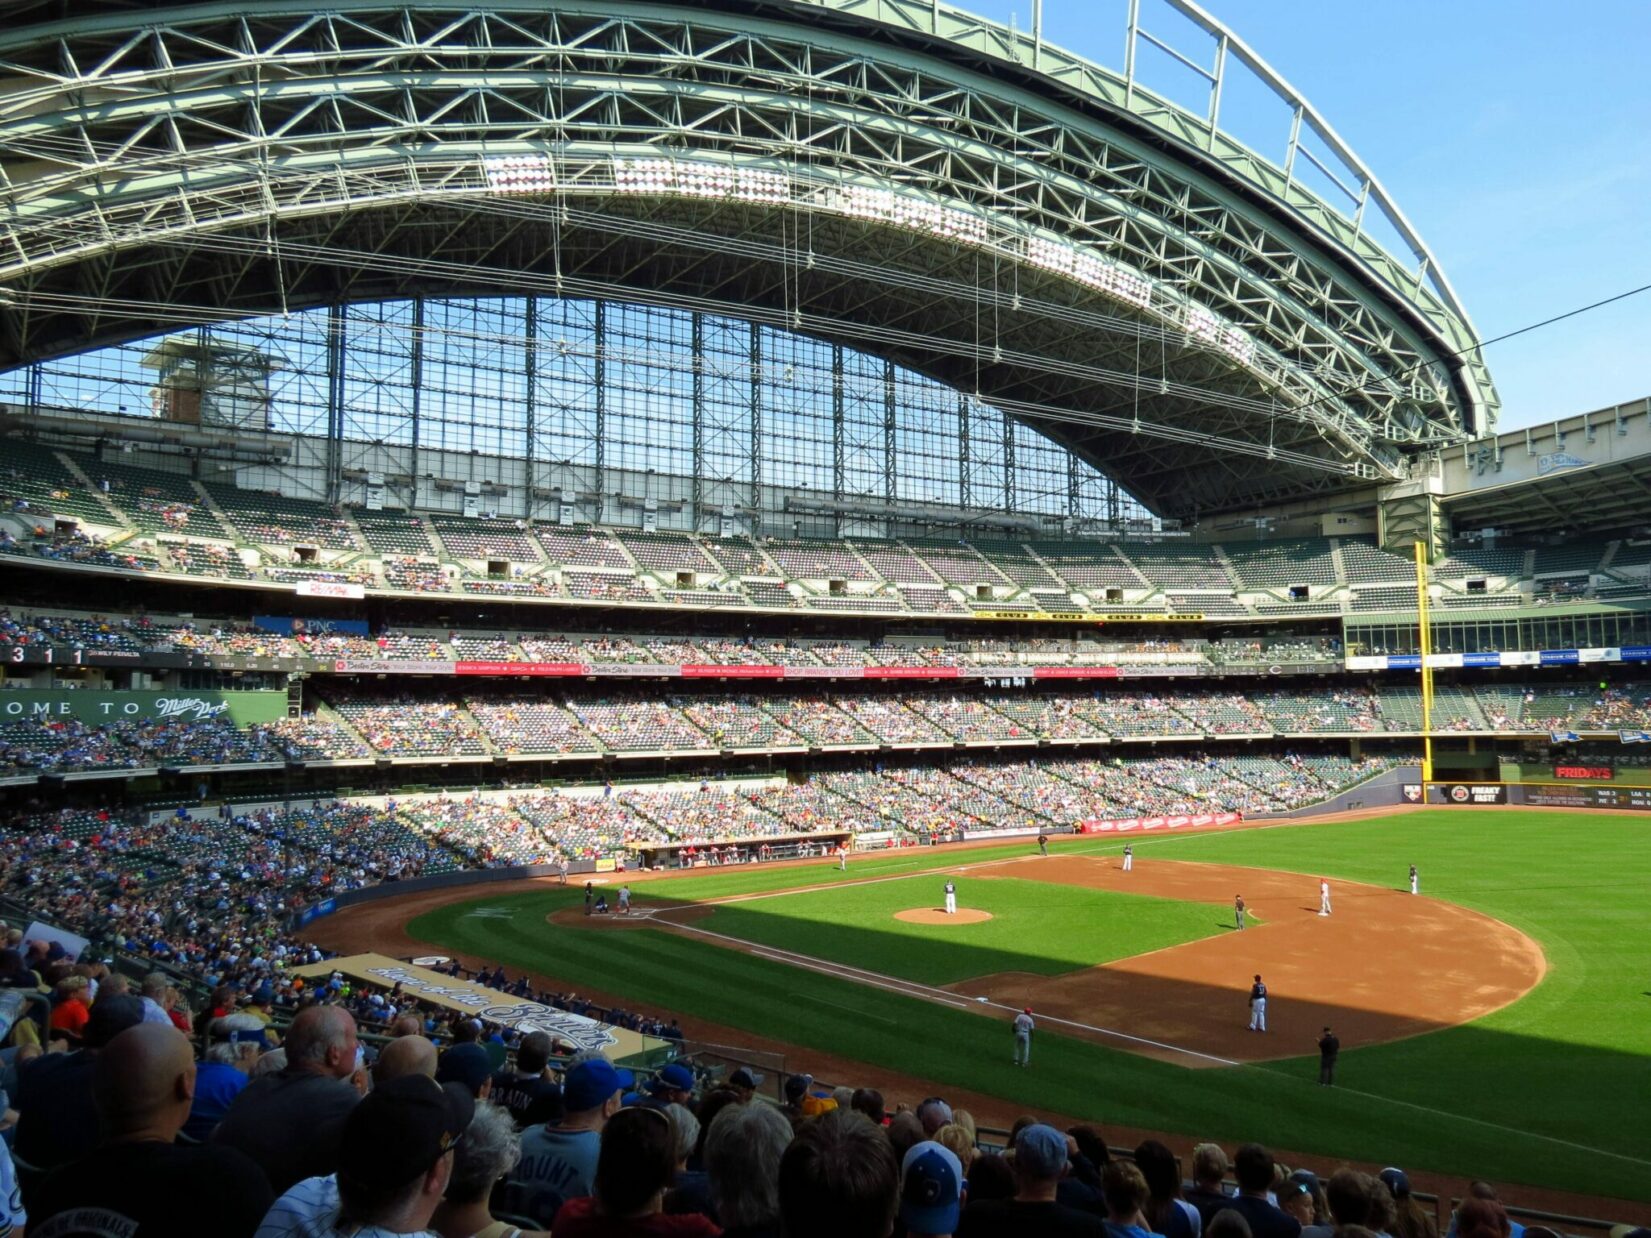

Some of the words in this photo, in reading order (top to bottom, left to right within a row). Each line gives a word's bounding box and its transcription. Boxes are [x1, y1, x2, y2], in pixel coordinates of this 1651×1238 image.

[307, 620, 336, 632] PNC
[13, 647, 25, 662] 3
[44, 648, 53, 663] 1
[73, 650, 82, 664] 1
[1555, 767, 1611, 779] FRIDAYS
[1471, 787, 1501, 795] FREAKY
[490, 1086, 533, 1112] BRAUN
